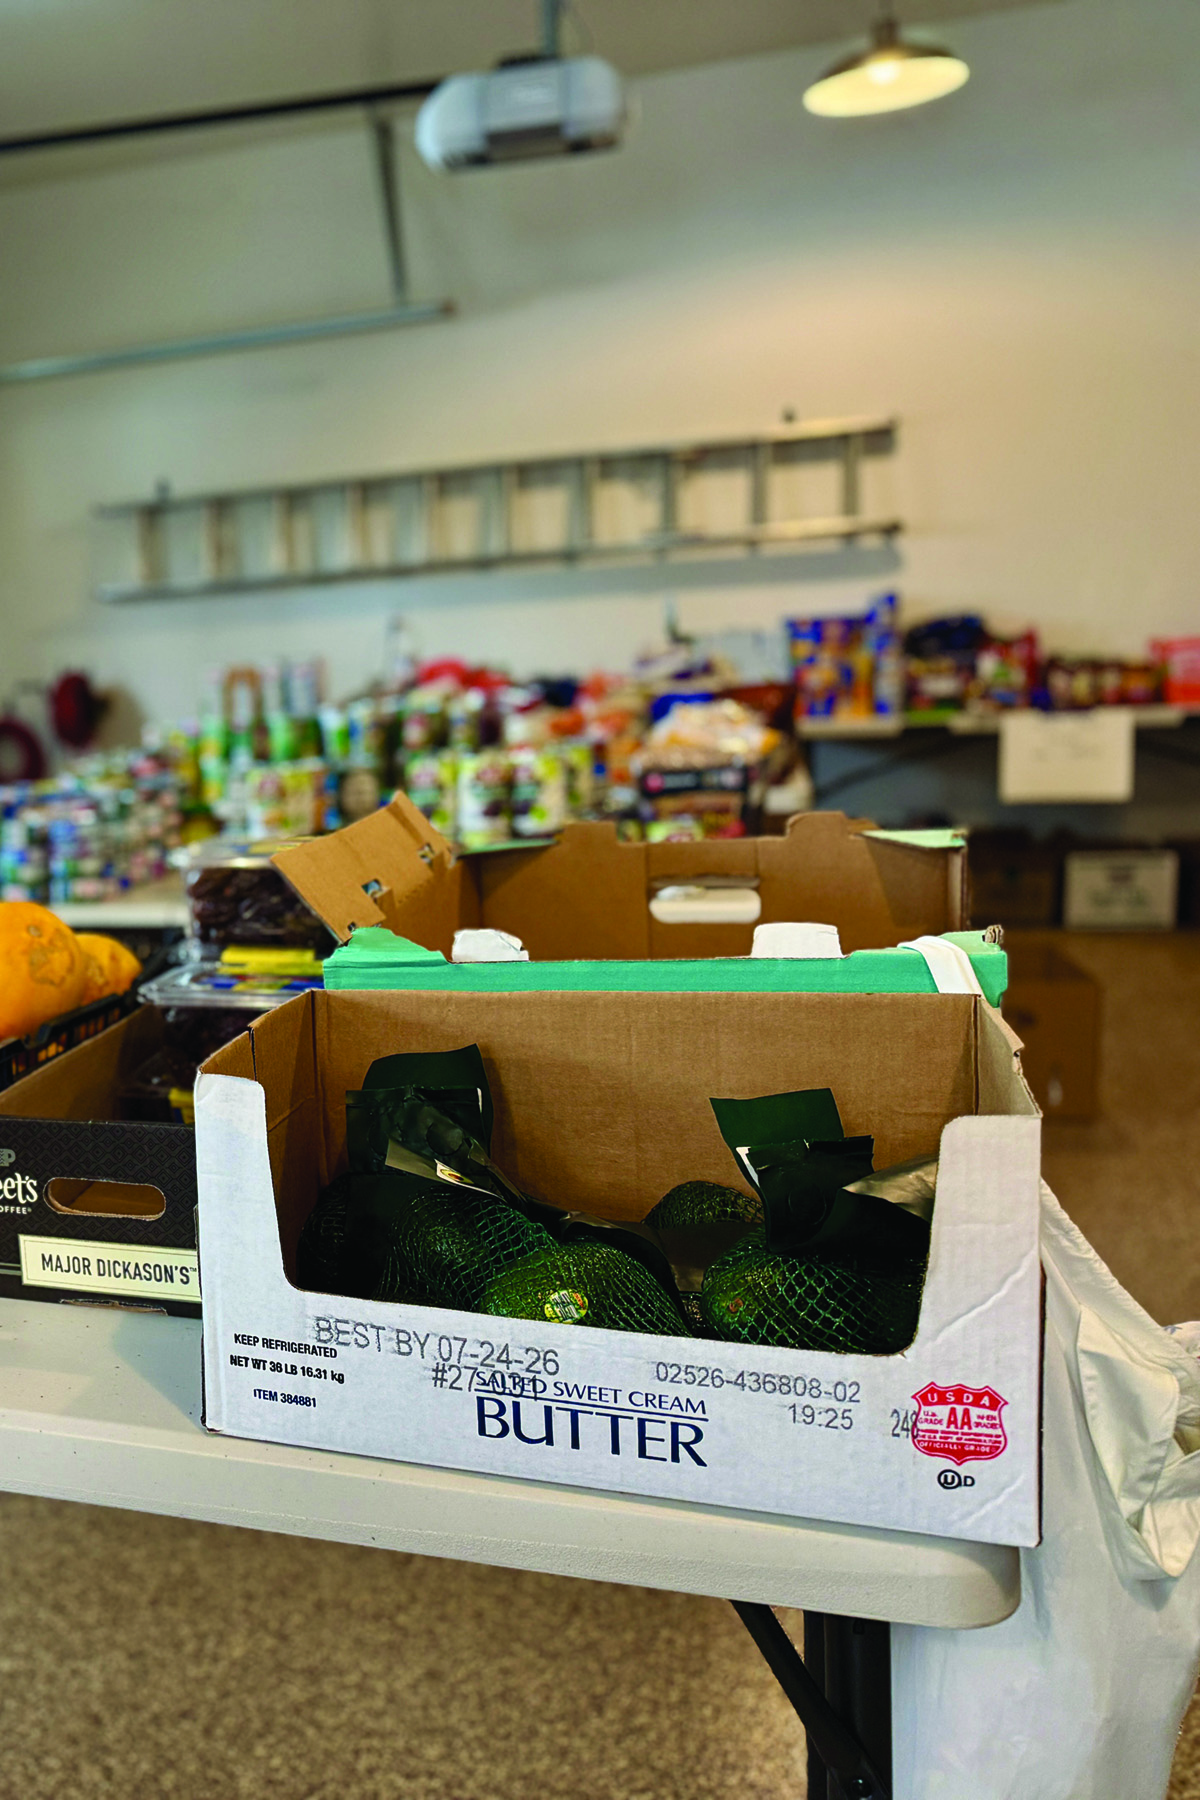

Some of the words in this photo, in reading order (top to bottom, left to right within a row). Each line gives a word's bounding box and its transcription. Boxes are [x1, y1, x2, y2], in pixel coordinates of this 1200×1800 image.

[41, 1253, 92, 1276] MAJOR
[234, 1333, 259, 1347] KEEP
[262, 1338, 338, 1358] REFRIGERATED
[313, 1315, 386, 1353] BEST
[396, 1328, 431, 1359] BY
[437, 1334, 560, 1376] 07-24-26
[230, 1354, 250, 1368] NET
[251, 1358, 267, 1371] WT
[285, 1363, 298, 1376] LB
[300, 1366, 327, 1380] 16.31
[331, 1370, 345, 1384] kg
[656, 1361, 861, 1403] 02526-436808-02
[253, 1388, 278, 1402] ITEM
[280, 1392, 317, 1408] 384881
[553, 1381, 622, 1404] SWEET
[628, 1391, 707, 1415] CREAM
[787, 1404, 854, 1430] 19:25
[946, 1406, 972, 1430] AA
[476, 1396, 708, 1468] BUTTER
